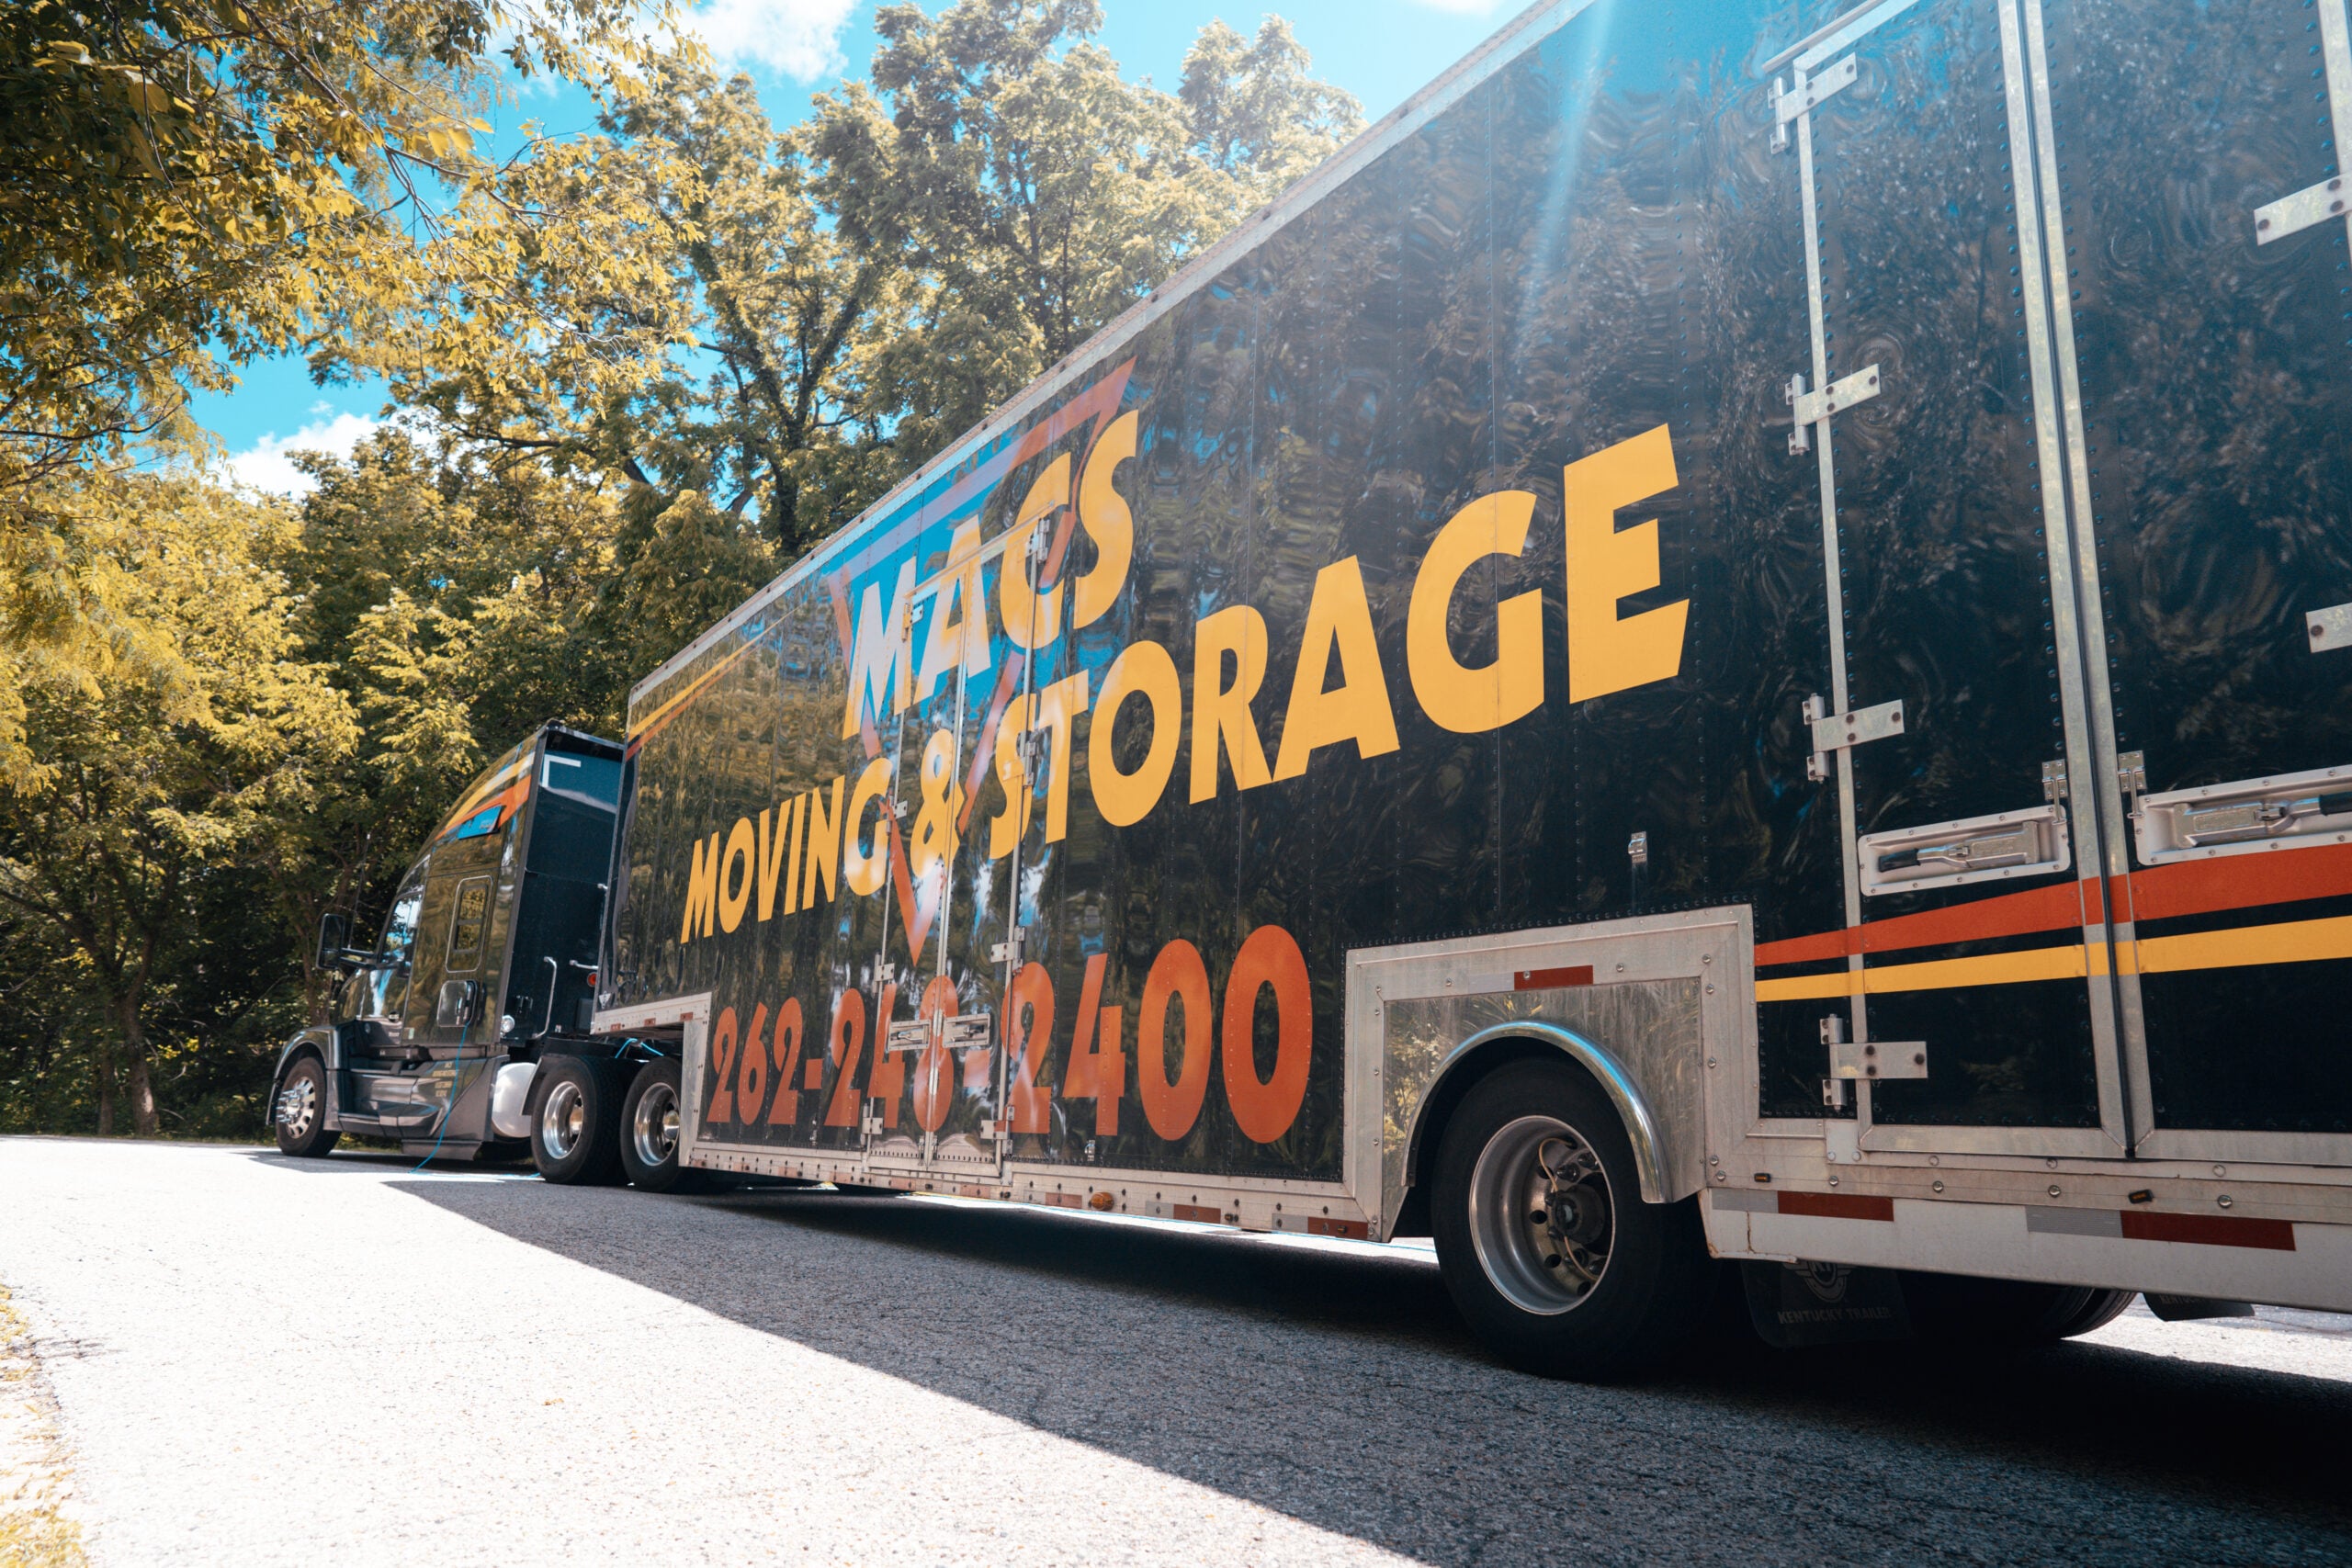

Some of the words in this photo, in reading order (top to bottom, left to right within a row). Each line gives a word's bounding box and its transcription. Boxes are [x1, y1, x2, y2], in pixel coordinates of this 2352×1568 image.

[680, 757, 893, 944] MOVING
[910, 728, 966, 879] &
[989, 423, 1690, 827] STORAGE
[842, 409, 1139, 740] MACS
[706, 924, 1314, 1144] 262-248-2400
[1777, 1307, 1844, 1325] KENTUCKY
[1847, 1306, 1892, 1320] TRAILER
